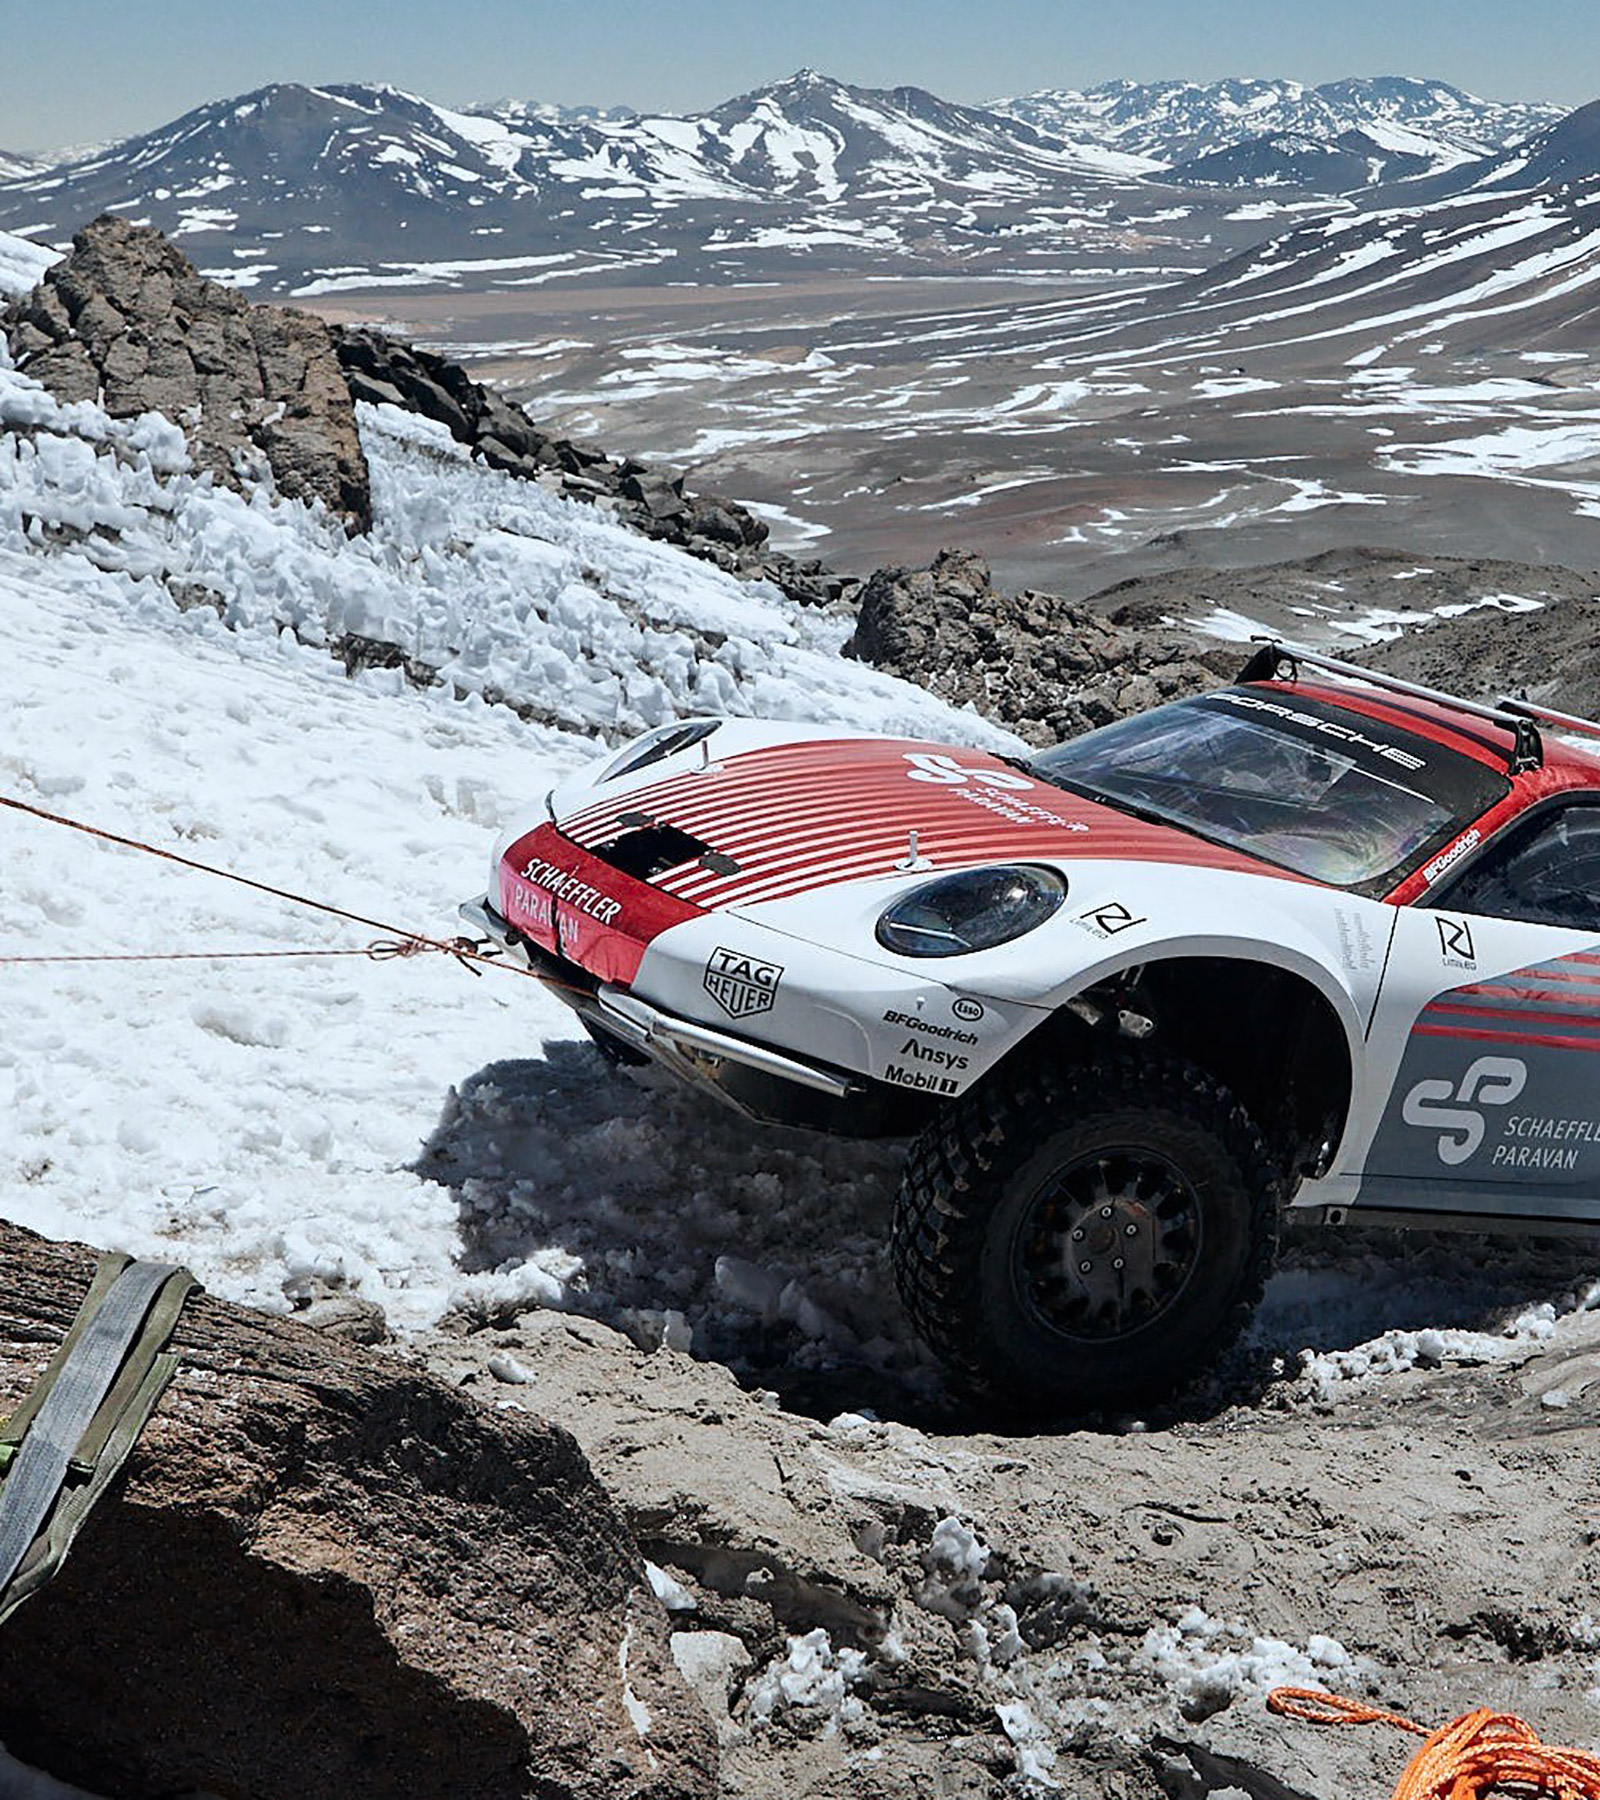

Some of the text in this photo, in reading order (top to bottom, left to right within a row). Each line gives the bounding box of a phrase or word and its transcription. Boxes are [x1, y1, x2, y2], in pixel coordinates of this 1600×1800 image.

[1205, 694, 1426, 770] PORSCHE
[1422, 829, 1481, 881] BFGoodrich
[520, 858, 622, 925] SCHAEFFLER
[719, 952, 775, 987] TAG
[707, 974, 771, 1014] HEUER
[883, 1009, 979, 1046] BFGoodrich
[900, 1038, 969, 1071] Ansys
[884, 1064, 938, 1091] Mobil
[1492, 1145, 1579, 1170] PARAVAN
